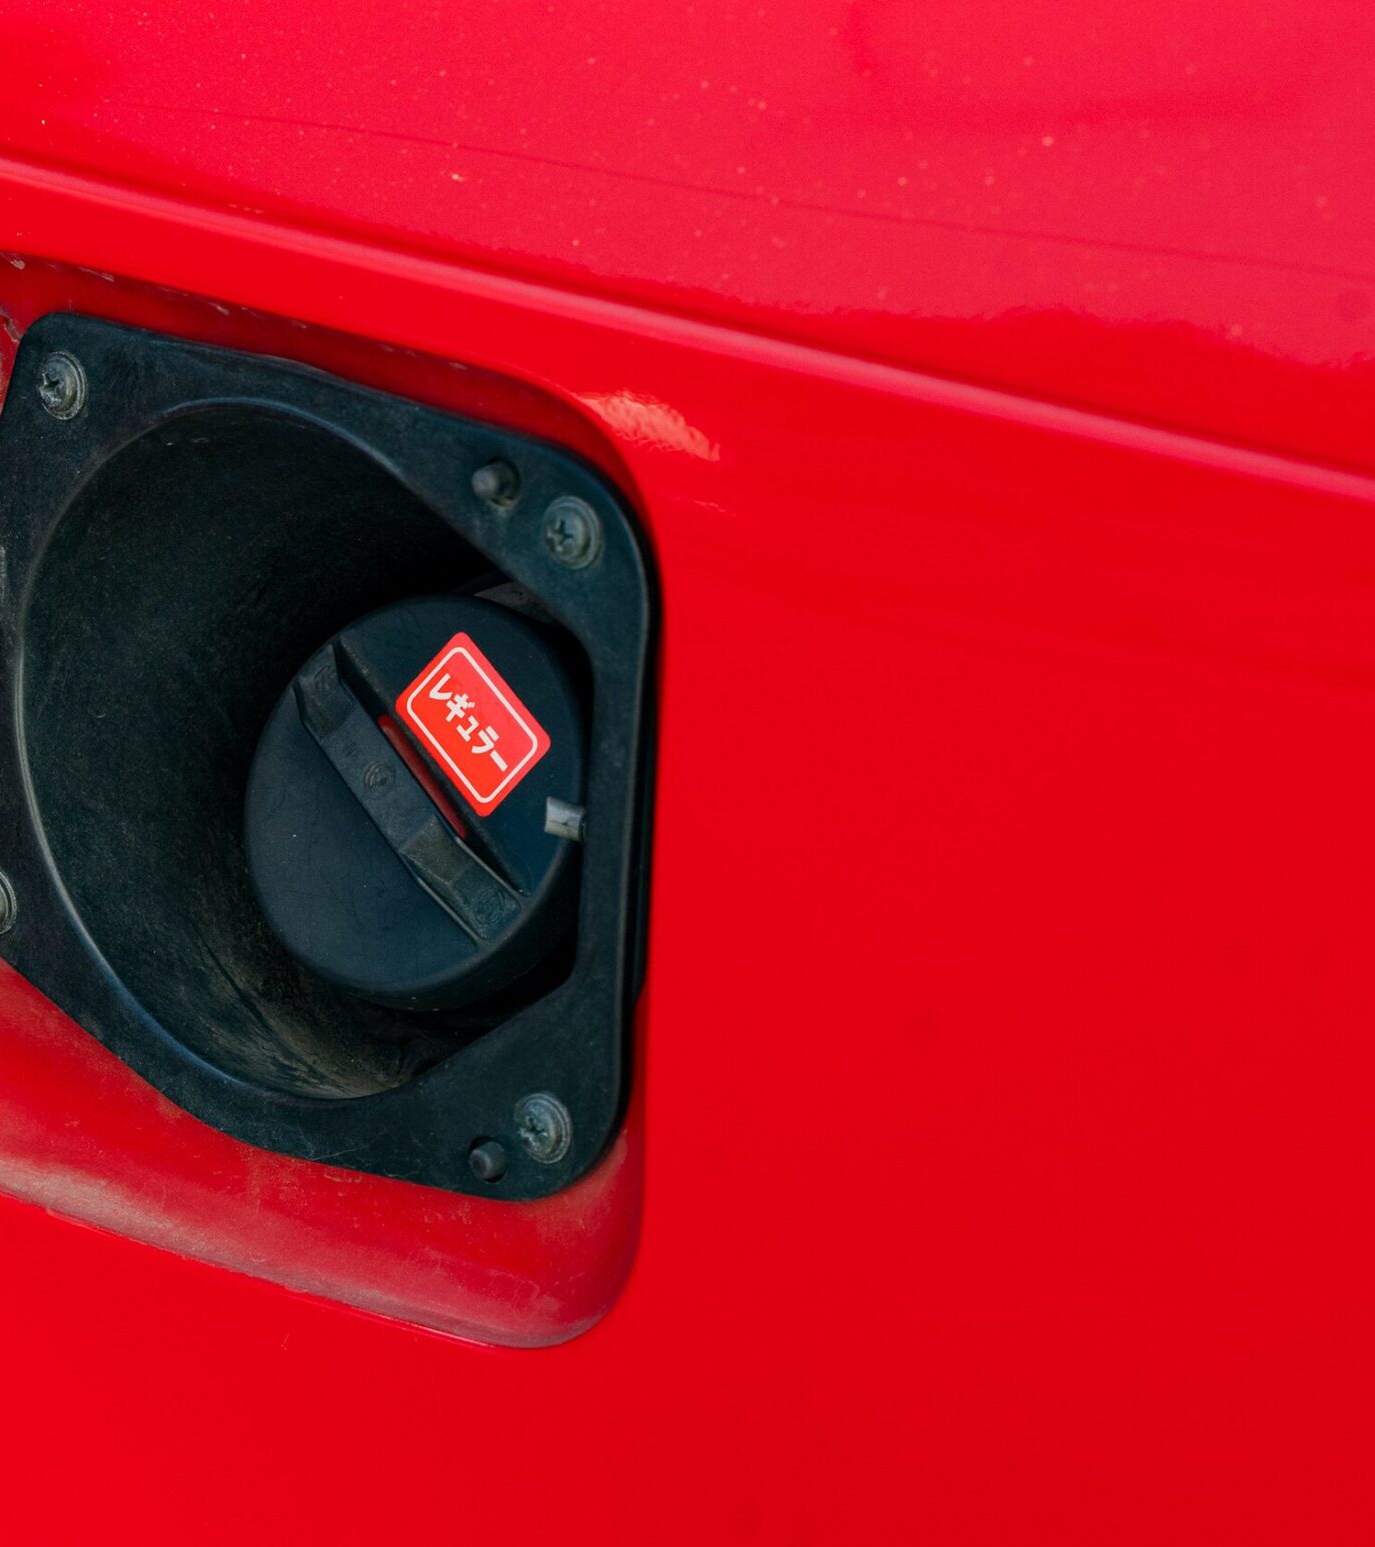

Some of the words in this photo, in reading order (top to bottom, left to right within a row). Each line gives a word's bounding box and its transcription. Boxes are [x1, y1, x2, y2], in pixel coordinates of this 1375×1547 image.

[428, 672, 508, 772] レギュラー
